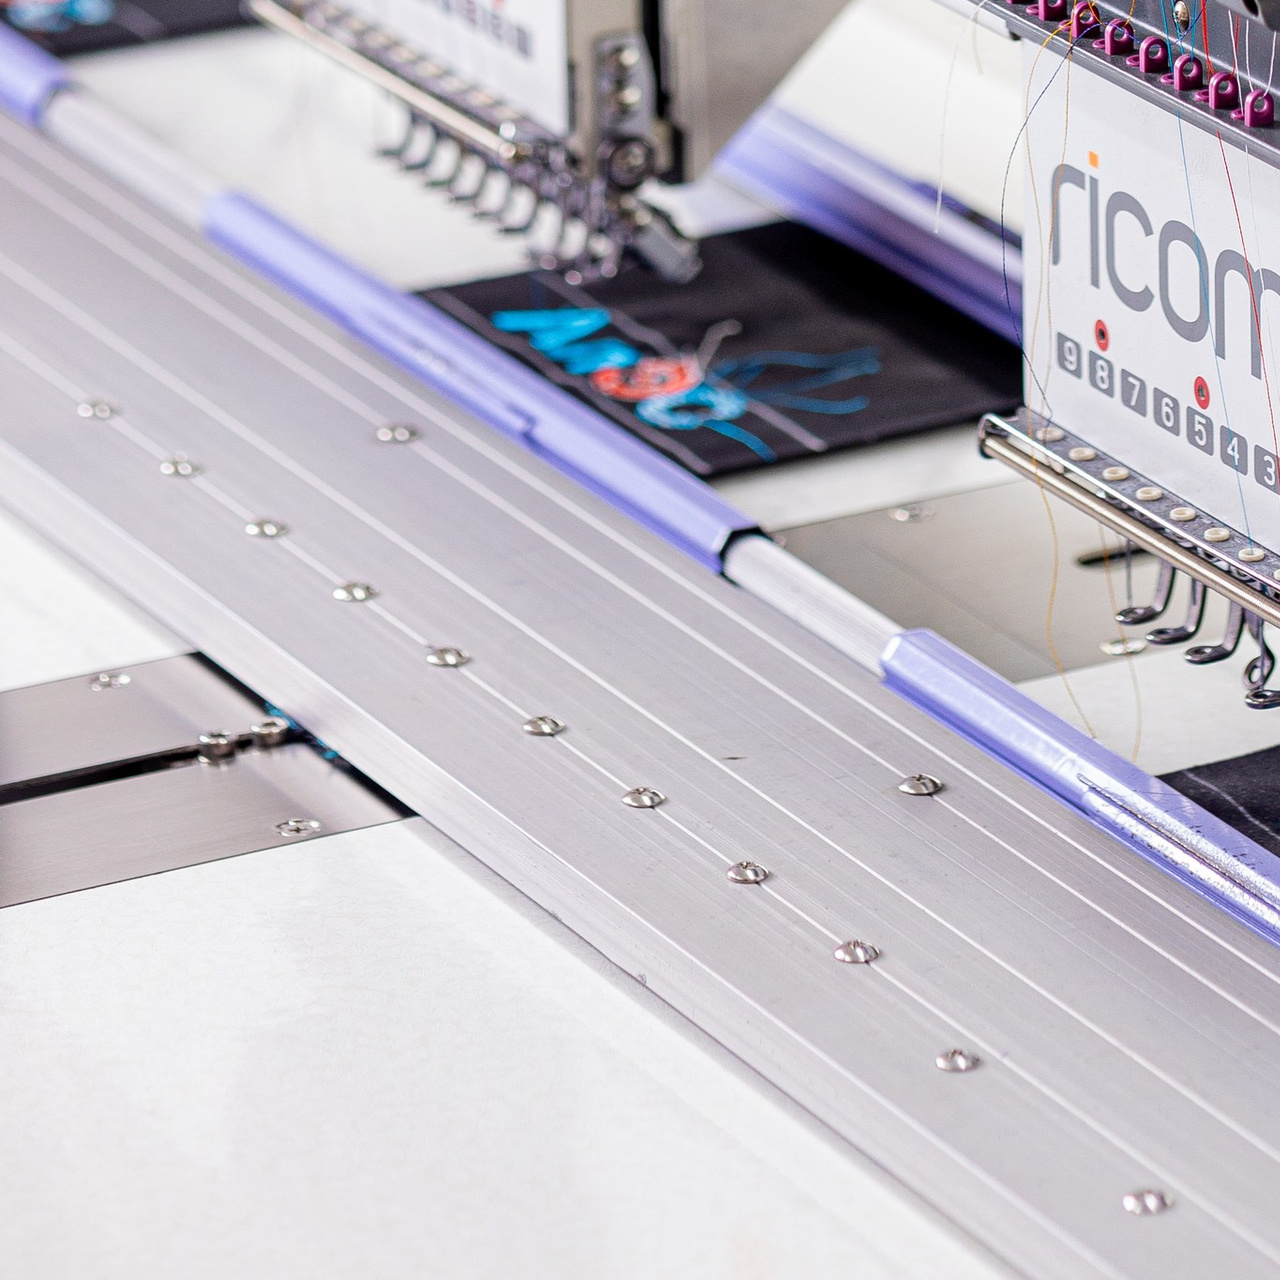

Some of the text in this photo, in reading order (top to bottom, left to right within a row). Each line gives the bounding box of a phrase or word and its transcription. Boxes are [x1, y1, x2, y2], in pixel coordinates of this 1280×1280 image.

[1062, 339, 1079, 372] 9
[1094, 358, 1110, 391] 8
[1126, 375, 1142, 408] 7
[1160, 396, 1175, 429] 6
[1193, 413, 1208, 447] 5
[1226, 435, 1241, 467] 4
[1262, 453, 1277, 487] 3
